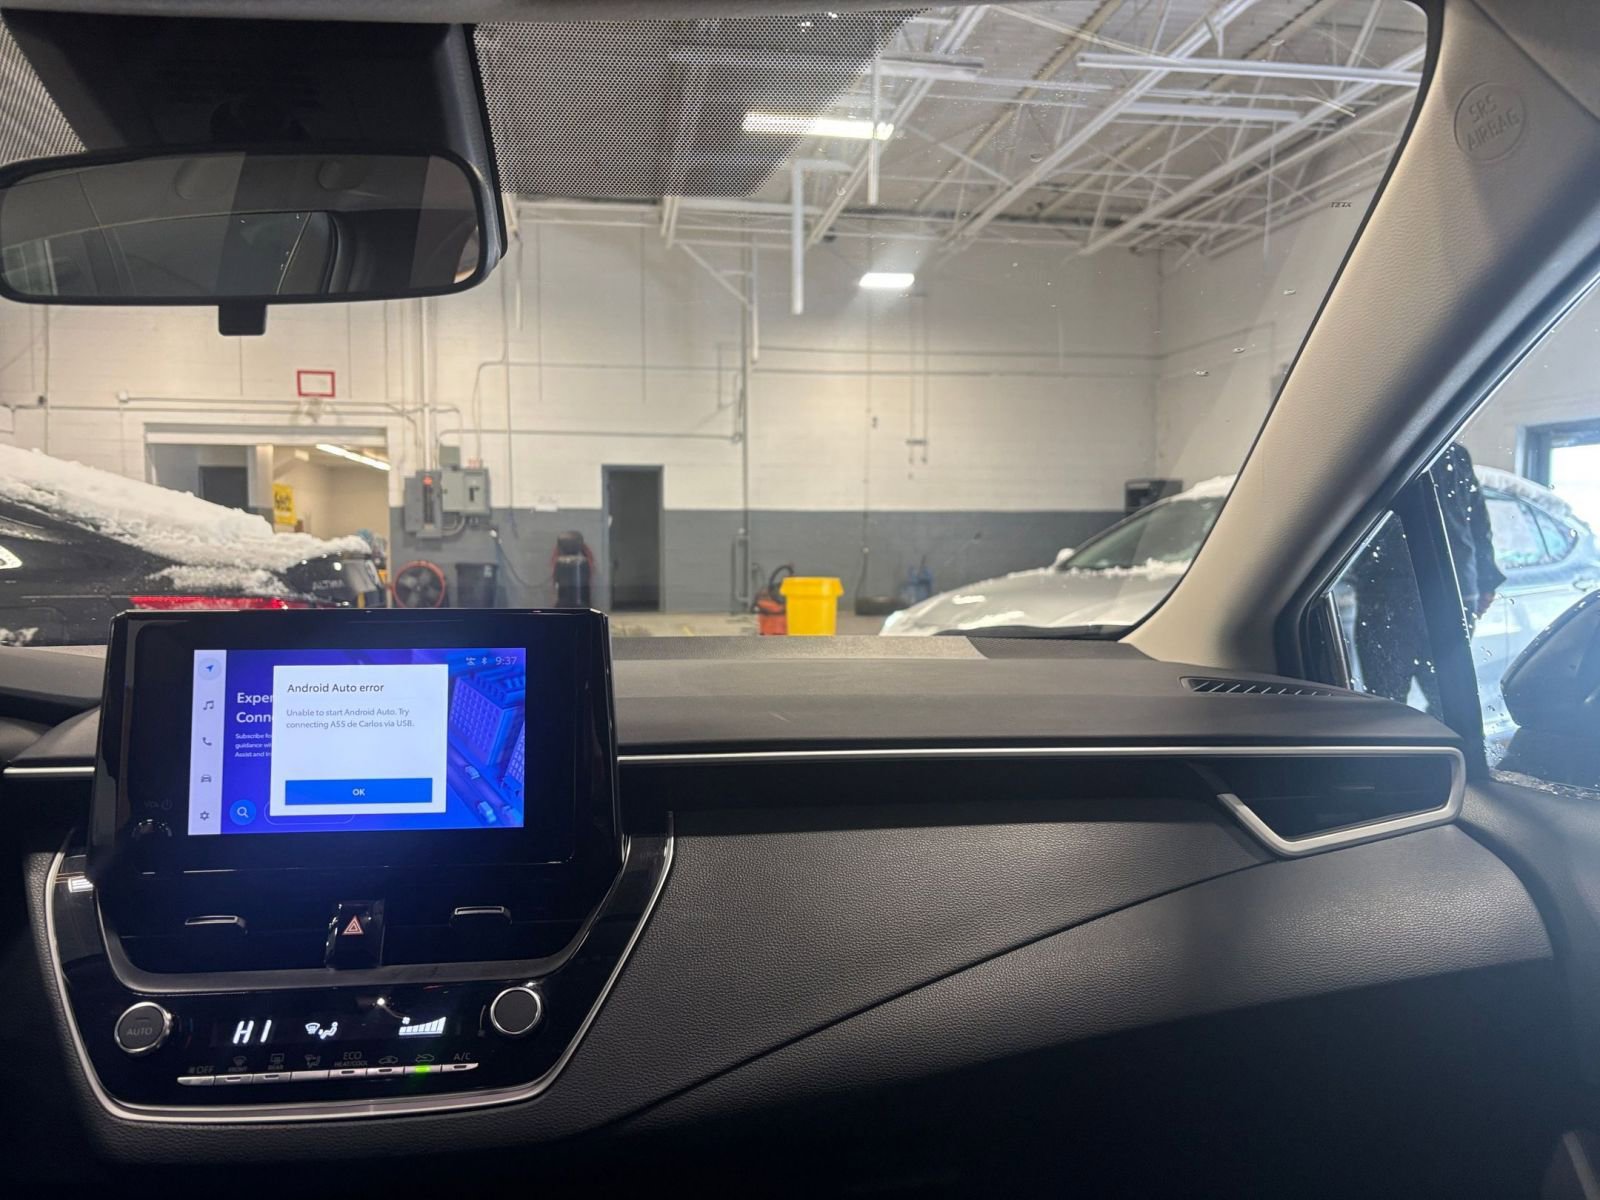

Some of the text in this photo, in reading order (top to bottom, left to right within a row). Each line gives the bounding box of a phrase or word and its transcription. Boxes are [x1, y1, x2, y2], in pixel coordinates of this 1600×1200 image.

[1468, 93, 1497, 123] SRS
[1467, 107, 1520, 152] AIRBAG
[495, 656, 517, 666] 9:37
[287, 683, 385, 693] Android Auto error
[236, 711, 273, 723] Conn
[286, 708, 410, 718] Unable to start Android Auto. Try
[286, 720, 329, 730] connecting
[348, 720, 357, 729] de
[358, 719, 383, 728] Carlos
[384, 719, 395, 728] via
[396, 719, 415, 728] USB.
[235, 742, 262, 750] guidance
[352, 788, 366, 797] OK
[126, 1026, 153, 1037] AUTO
[232, 1019, 272, 1044] HI
[342, 1051, 362, 1061] ECO
[453, 1051, 471, 1061] A/C
[196, 1065, 215, 1075] OFF
